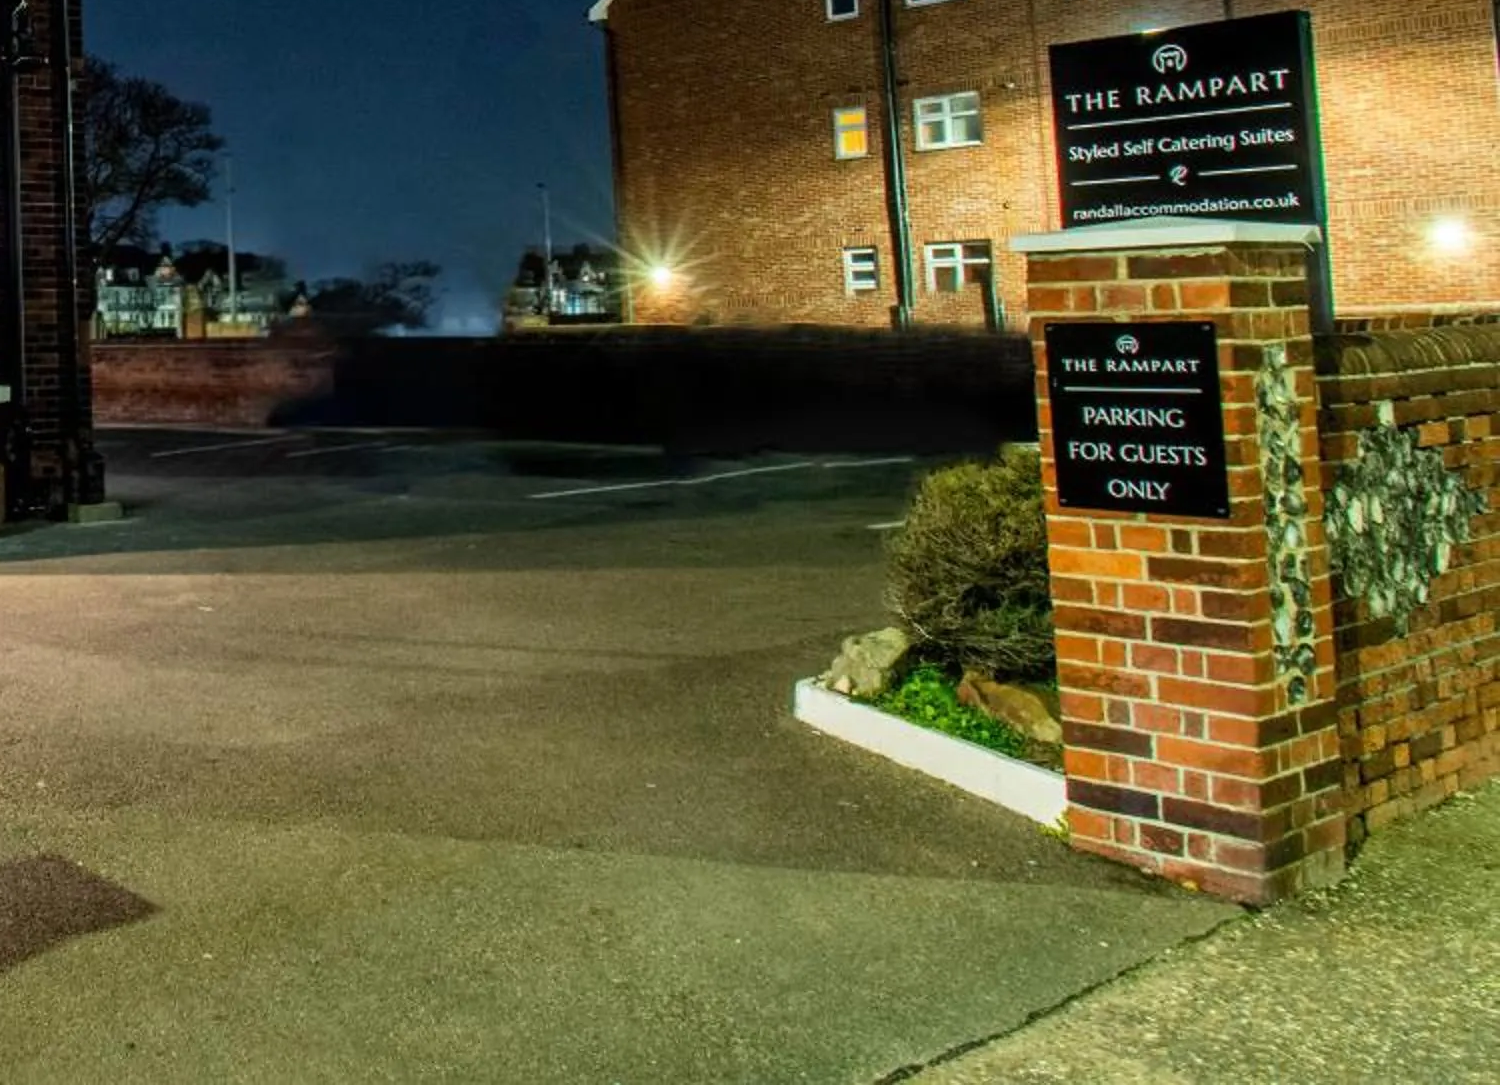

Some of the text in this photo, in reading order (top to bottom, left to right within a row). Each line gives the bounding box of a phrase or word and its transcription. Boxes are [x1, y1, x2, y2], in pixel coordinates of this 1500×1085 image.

[1065, 68, 1291, 113] THE RAMPART
[1069, 127, 1295, 163] Styled Self Catering Suites
[1073, 191, 1301, 220] randallaccommodation.co.uk
[1061, 358, 1201, 373] THE RAMPART
[1083, 406, 1186, 428] PARKING
[1068, 441, 1208, 466] FOR GUESTS
[1107, 479, 1171, 500] ONLY
